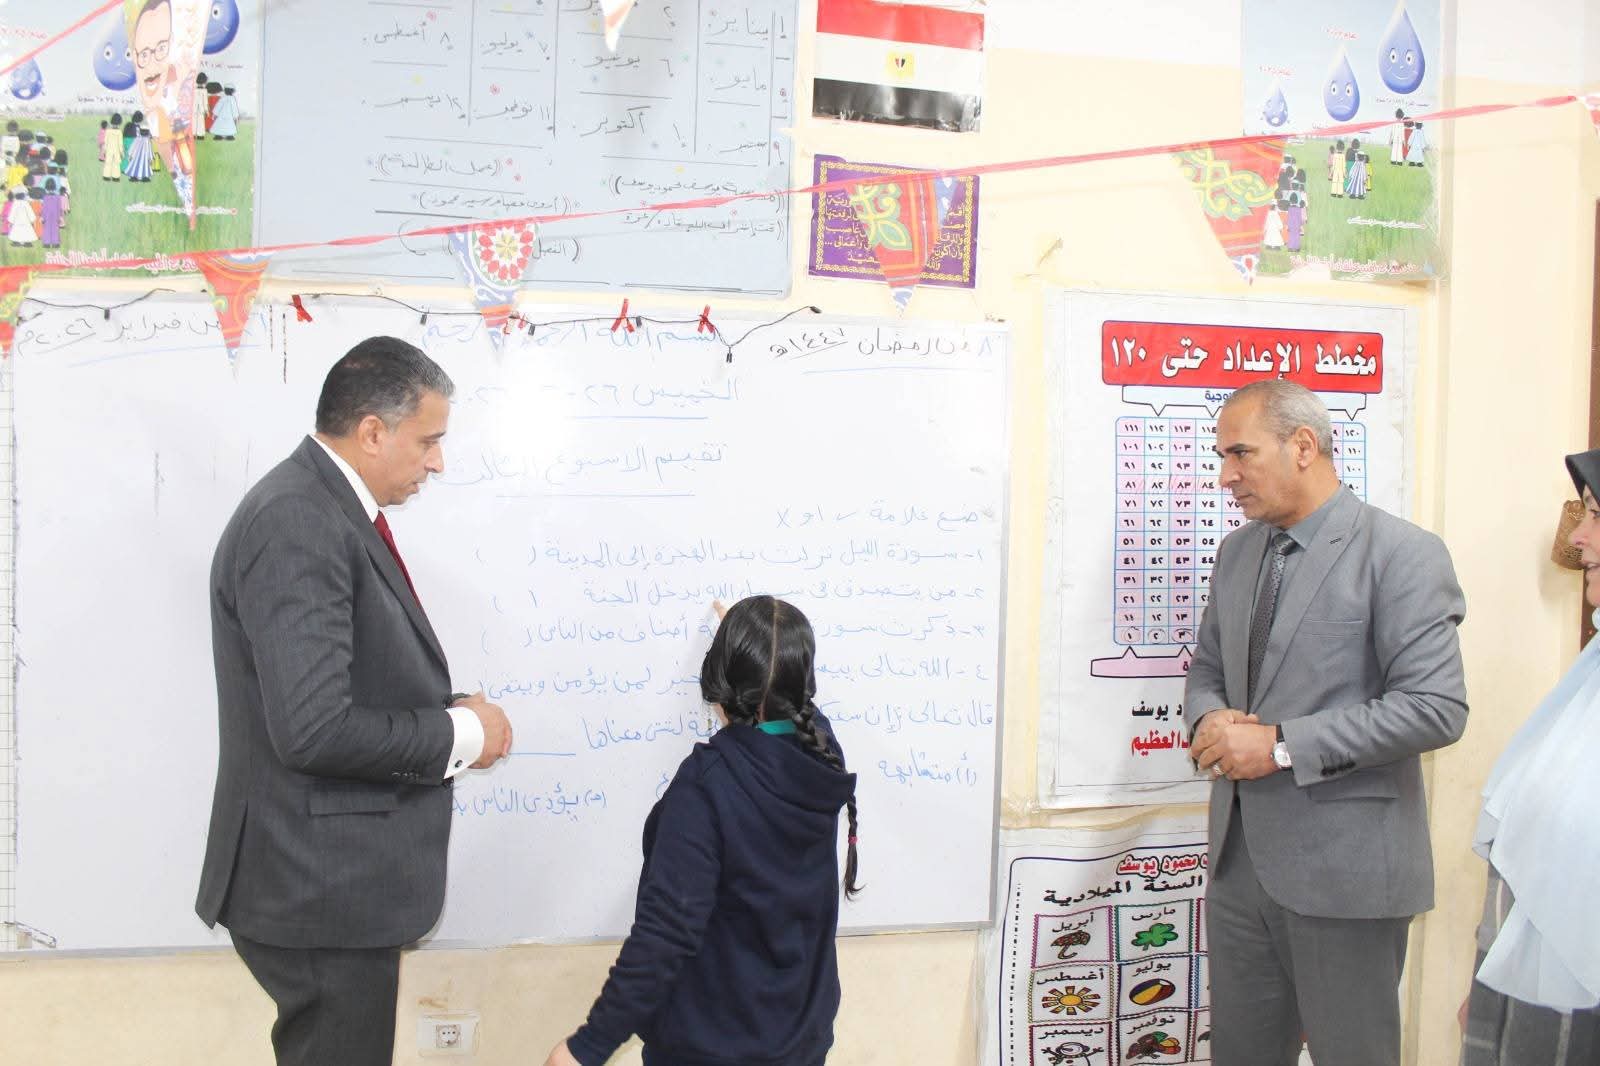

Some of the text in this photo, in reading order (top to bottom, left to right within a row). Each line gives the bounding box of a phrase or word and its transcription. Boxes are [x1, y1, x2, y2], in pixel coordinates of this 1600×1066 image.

[1111, 335, 1147, 368] ١٢٠
[1160, 334, 1209, 378] حتى
[1314, 342, 1377, 377] مخطط
[1124, 424, 1139, 432] ١١١
[1149, 424, 1165, 433] ١١٢
[1174, 425, 1191, 433] ١١٣
[1123, 442, 1139, 451] ١٠١
[1147, 443, 1164, 451] ١٠٢
[1173, 443, 1191, 452] ١٠٣
[1124, 461, 1136, 470] ٩١
[1150, 462, 1164, 470] ٩٢
[1176, 462, 1191, 470] ٩٣
[1201, 463, 1215, 471] ٩٤
[1124, 480, 1137, 489] ٨١
[1151, 481, 1164, 490] ٨٢
[1176, 481, 1192, 490] ٨٣
[1202, 481, 1214, 490] ٨٤
[1124, 499, 1137, 508] ٧١
[1149, 499, 1164, 508] ٧٢
[1175, 500, 1191, 508] ٧٣
[1201, 500, 1216, 508] ٧٤
[1123, 518, 1135, 527] ٦١
[1149, 519, 1162, 527] ٦٢
[1176, 519, 1191, 527] ٦٣
[1200, 518, 1215, 527] ٦٤
[1227, 519, 1241, 531] ٦٥
[1122, 537, 1135, 546] ٥١
[1149, 537, 1163, 546] ٥٢
[1175, 537, 1191, 546] ٥٣
[1202, 537, 1215, 546] ٥٤
[840, 536, 880, 567] الليل
[887, 543, 958, 566] سورة
[1123, 556, 1136, 565] ٤١
[1150, 556, 1164, 565] ٤٢
[1175, 556, 1190, 565] ٤٣
[1123, 576, 1137, 584] ٣١
[1149, 575, 1164, 584] ٣٢
[1174, 575, 1190, 584] ٣٣
[1200, 575, 1211, 584] ٣
[928, 587, 957, 602] من
[1150, 594, 1162, 603] ٢٢
[1175, 594, 1190, 603] ٢٣
[1200, 594, 1209, 602] ٢
[1122, 595, 1135, 604] ٢١
[1123, 614, 1135, 622] ١١
[1151, 613, 1162, 622] ١٢
[1175, 613, 1188, 621] ١٣
[590, 628, 616, 643] من
[821, 623, 878, 639] سور
[919, 656, 950, 680] الله
[908, 700, 962, 726] تعالى
[967, 699, 993, 727] قال
[1132, 701, 1168, 721] يوسف
[1131, 729, 1181, 757] العظيم
[472, 785, 519, 817] الناس
[1118, 855, 1157, 875] يوسف
[1162, 856, 1198, 873] محمود
[1043, 874, 1203, 907] السنة الميلادية
[1131, 906, 1176, 922] مارس
[1052, 911, 1094, 933] أبريل
[1132, 960, 1172, 977] يوليو
[1036, 968, 1105, 986] أغسطس
[1126, 1014, 1176, 1035] نوفمبر
[1037, 1027, 1105, 1041] ديسمبر
